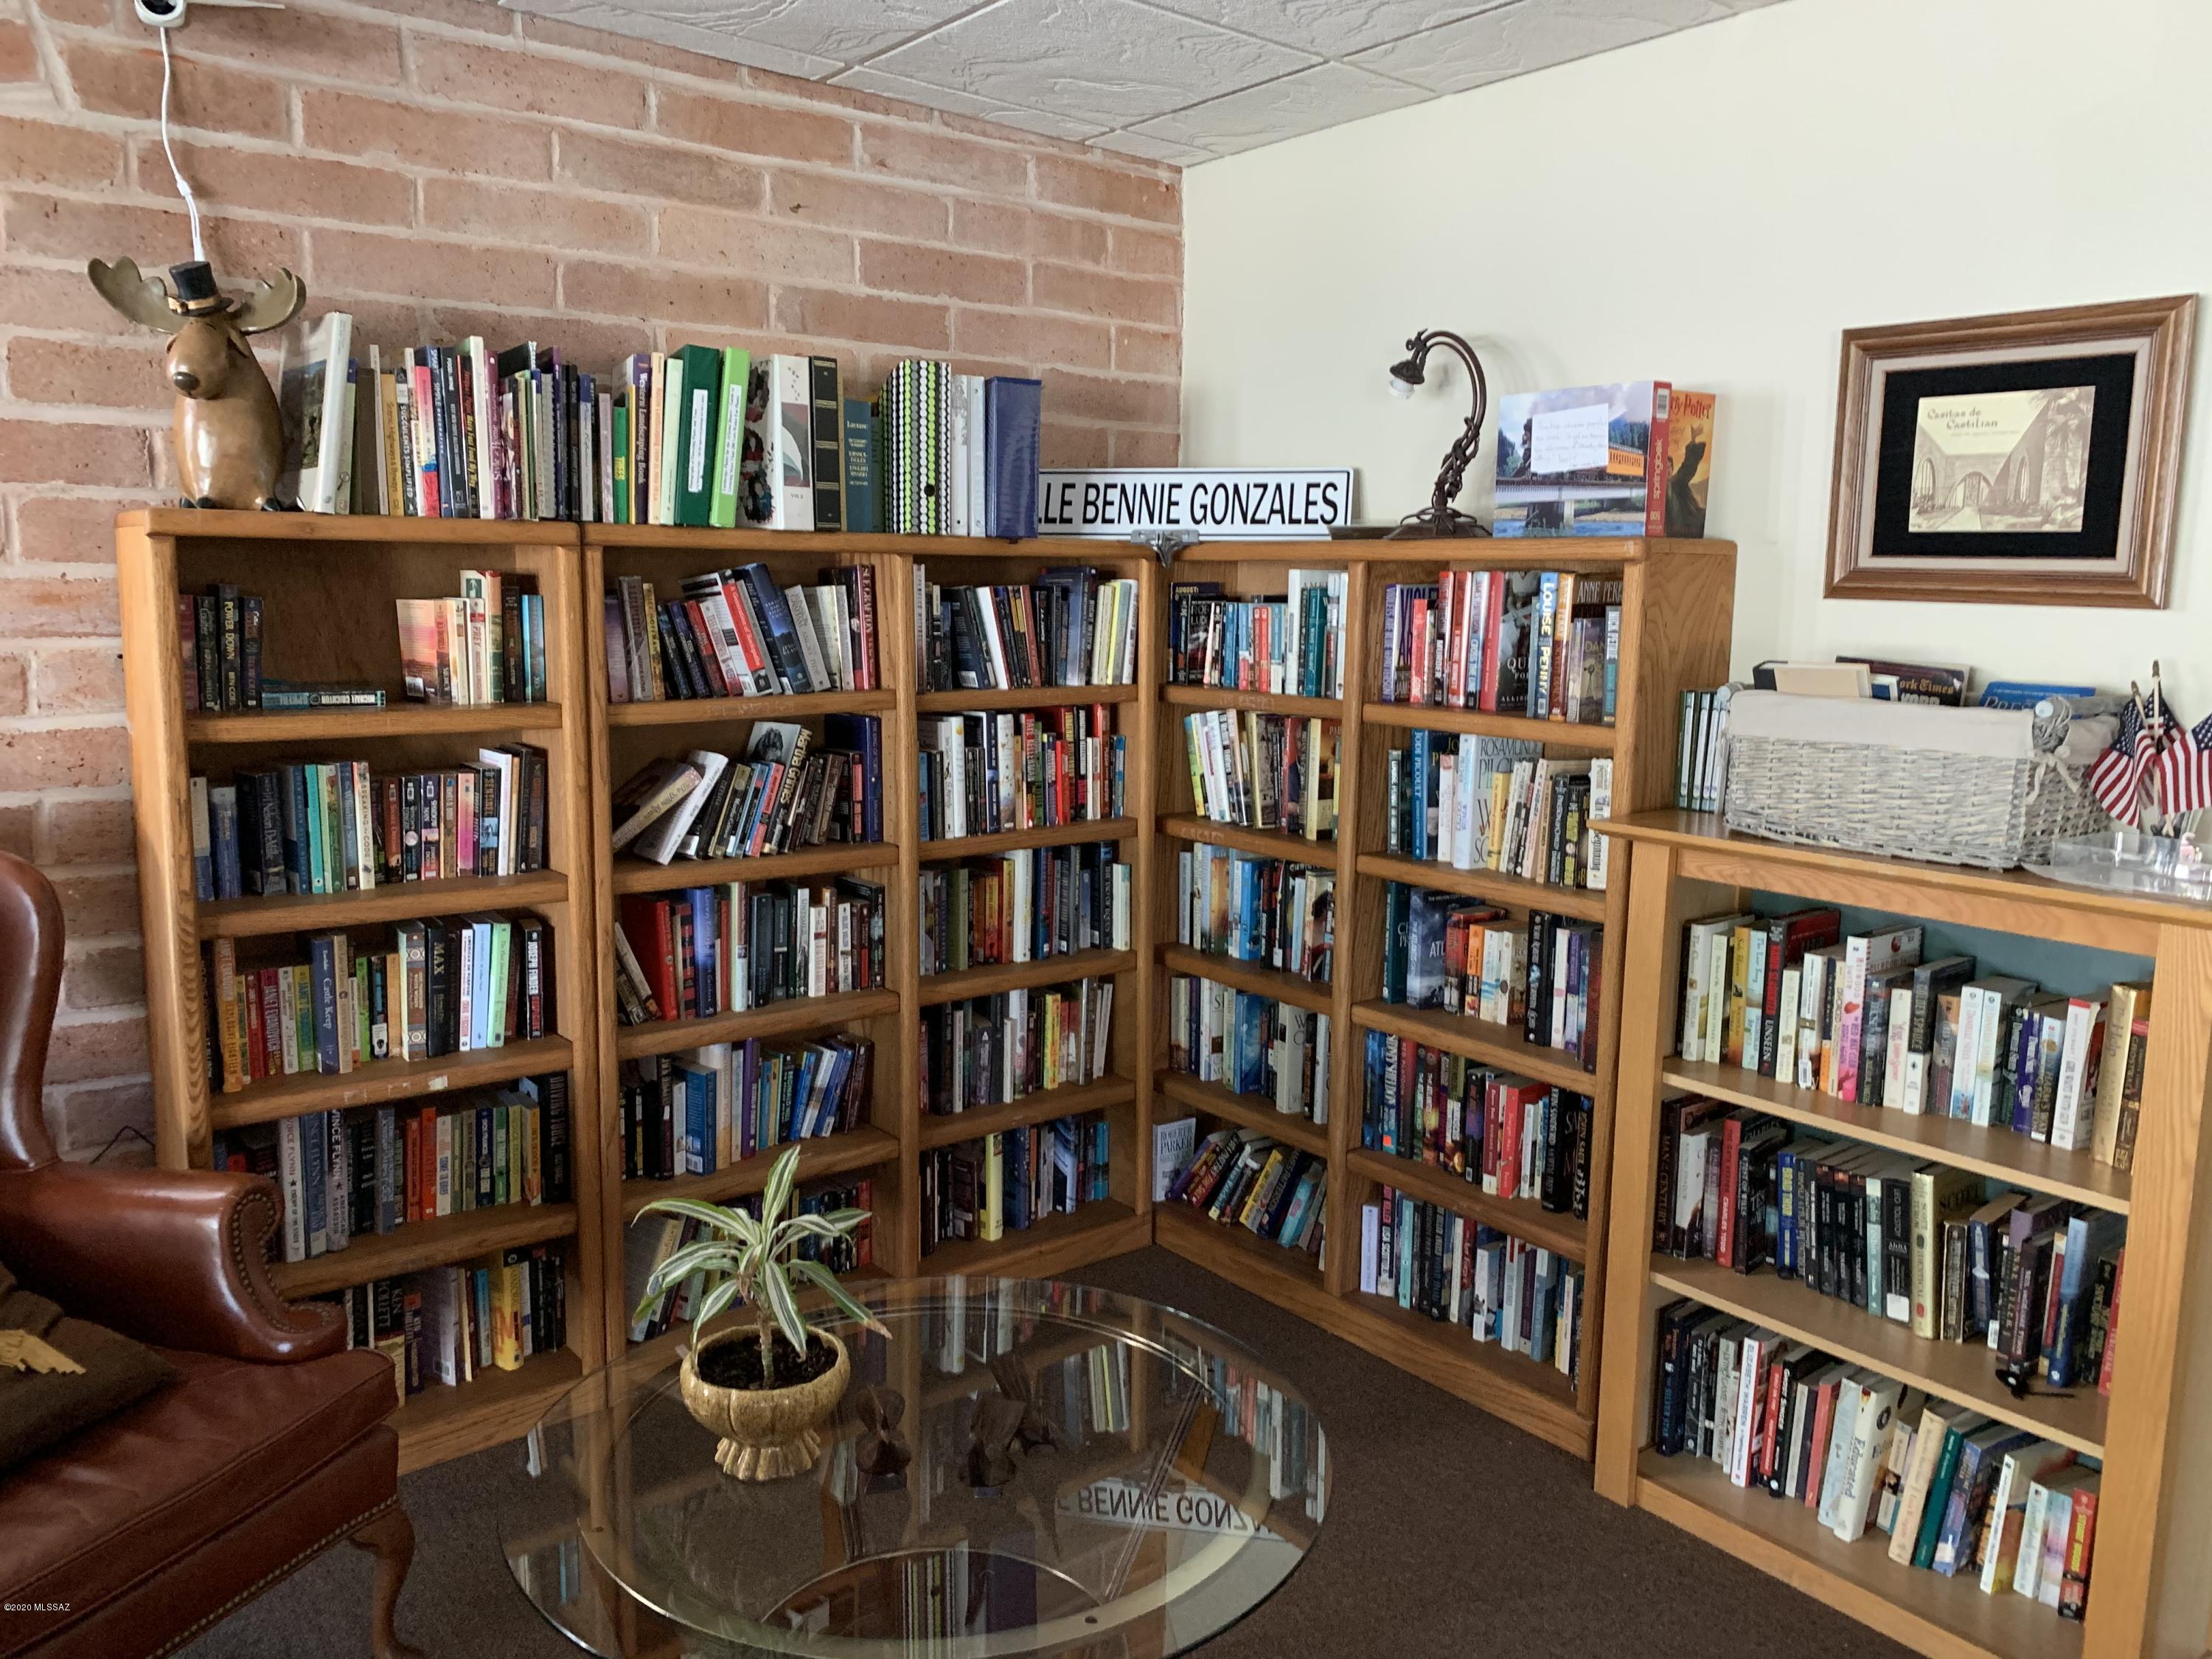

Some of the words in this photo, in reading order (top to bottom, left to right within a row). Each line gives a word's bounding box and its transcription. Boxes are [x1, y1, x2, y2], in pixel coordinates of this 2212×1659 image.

[431, 349, 439, 373] SMART
[639, 373, 647, 406] Western
[386, 403, 396, 425] Scenic
[1683, 393, 1711, 420] Potter
[1969, 406, 1982, 417] de
[388, 428, 397, 461] Highways
[637, 409, 646, 460] Landscaping
[400, 406, 410, 454] SUCCULENTS
[405, 456, 414, 498] SIMPLIFIED
[389, 467, 399, 493] Byways
[468, 464, 475, 473] My
[638, 462, 646, 484] Book
[1037, 483, 1076, 524] LE
[1081, 483, 1183, 524] BENNIE
[1189, 482, 1338, 525] GONZALES
[1577, 581, 1600, 603] ANNE
[225, 602, 234, 630] POWER
[863, 588, 873, 633] GRAFTON
[1542, 582, 1554, 636] LOUISE
[226, 633, 234, 659] DOWN
[473, 626, 481, 647] PREY
[1434, 639, 1444, 678] MURDER
[1539, 647, 1551, 695] PENNY
[1899, 679, 1918, 690] ork
[1919, 678, 1955, 695] Times
[792, 728, 812, 766] Martha
[1413, 731, 1423, 755] JODI
[780, 767, 801, 804] Grimes
[1414, 757, 1423, 797] PICOULT
[263, 802, 274, 828] Nelson
[265, 831, 278, 860] DeMille
[1590, 830, 1604, 871] eginning
[1104, 896, 1110, 907] OF
[434, 942, 445, 974] MAX
[528, 942, 538, 968] JOSEPH
[264, 986, 278, 1009] JANET
[323, 978, 332, 1004] Castle
[529, 969, 538, 995] FINDER
[265, 1010, 280, 1051] EVANOVICH
[324, 1006, 333, 1029] Keep
[1762, 1020, 1773, 1062] UNSEEN
[2110, 1024, 2123, 1057] Help
[331, 1110, 341, 1143] VINCE
[332, 1144, 341, 1180] FLYNN
[1744, 1343, 1754, 1390] ELIZABETH
[1740, 1391, 1750, 1427] WARREN
[1845, 1438, 1865, 1500] Educated
